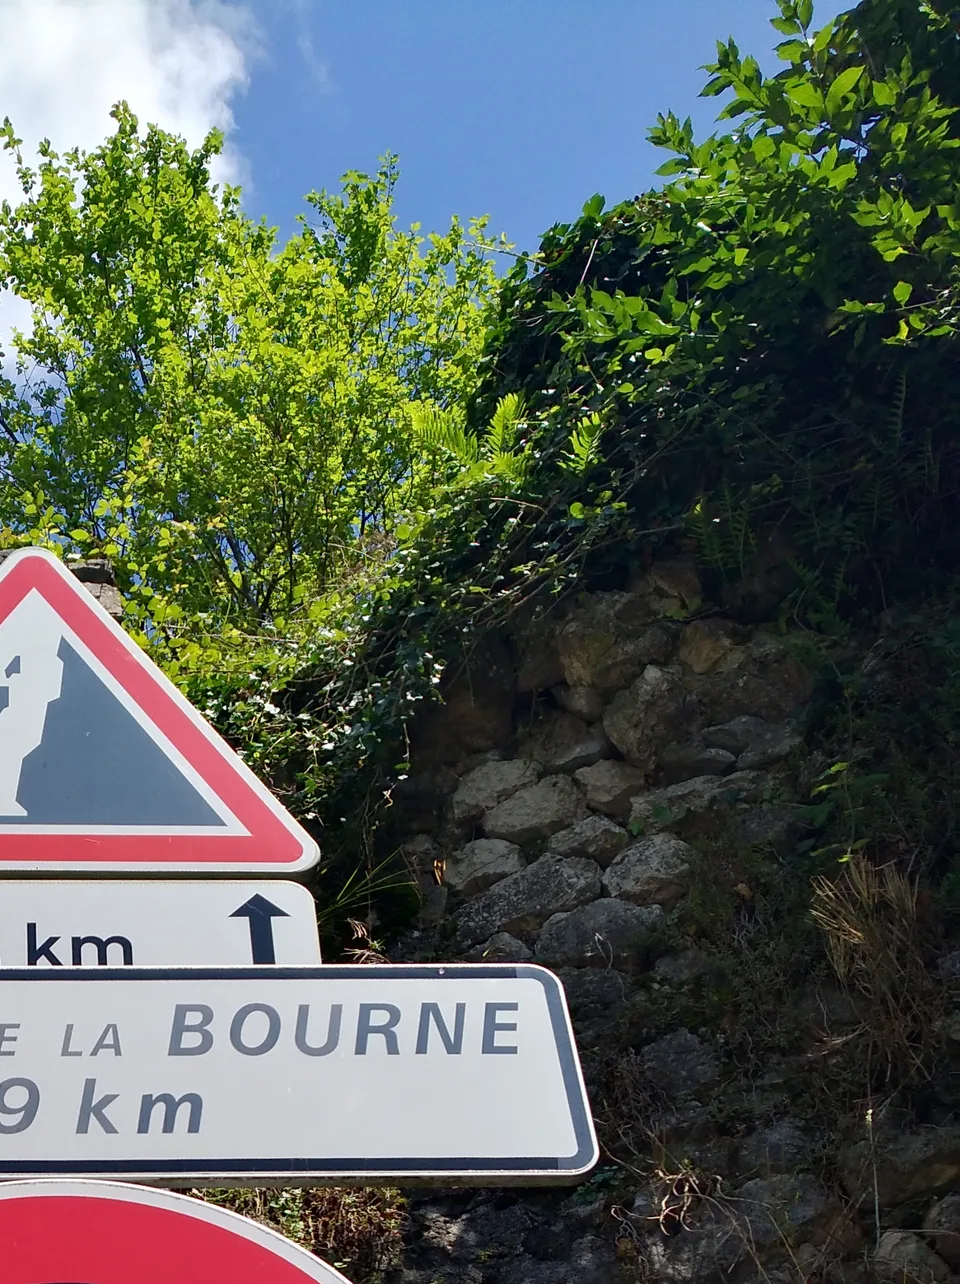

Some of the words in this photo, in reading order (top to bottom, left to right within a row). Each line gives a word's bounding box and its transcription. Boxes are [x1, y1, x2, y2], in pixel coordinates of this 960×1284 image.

[27, 922, 133, 965] km
[60, 1023, 122, 1056] LA
[168, 1002, 519, 1056] BOURNE
[76, 1078, 203, 1134] km
